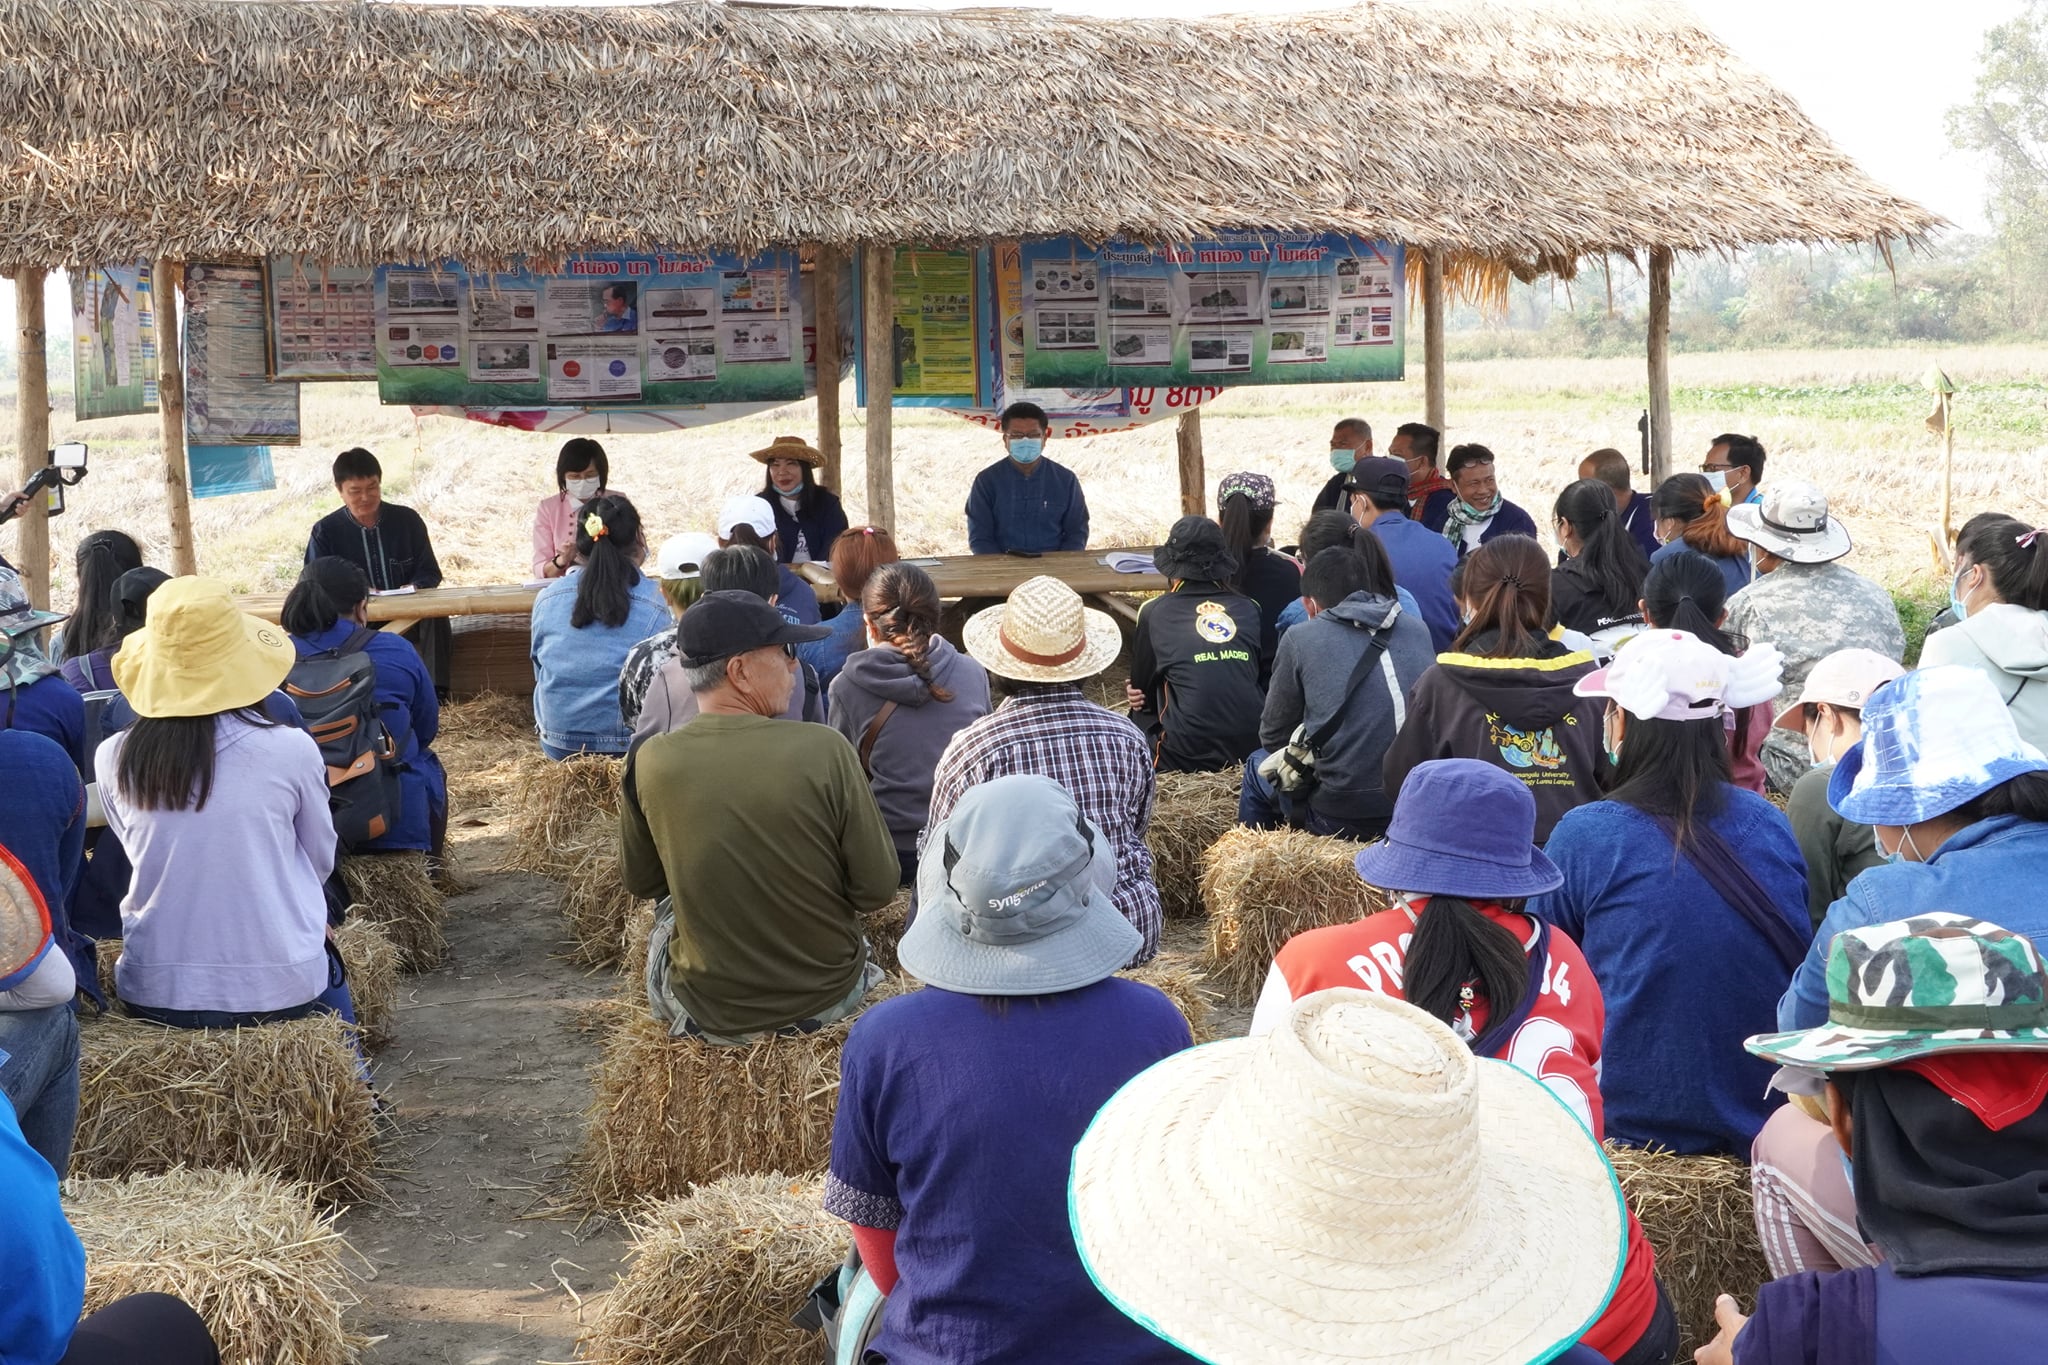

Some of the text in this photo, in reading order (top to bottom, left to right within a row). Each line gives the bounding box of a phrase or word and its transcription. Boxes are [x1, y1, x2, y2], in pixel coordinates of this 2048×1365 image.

[1200, 249, 1243, 263] หนอง
[573, 260, 619, 275] หนอง
[627, 261, 650, 275] นา
[1194, 650, 1249, 663] REAL MADRID
